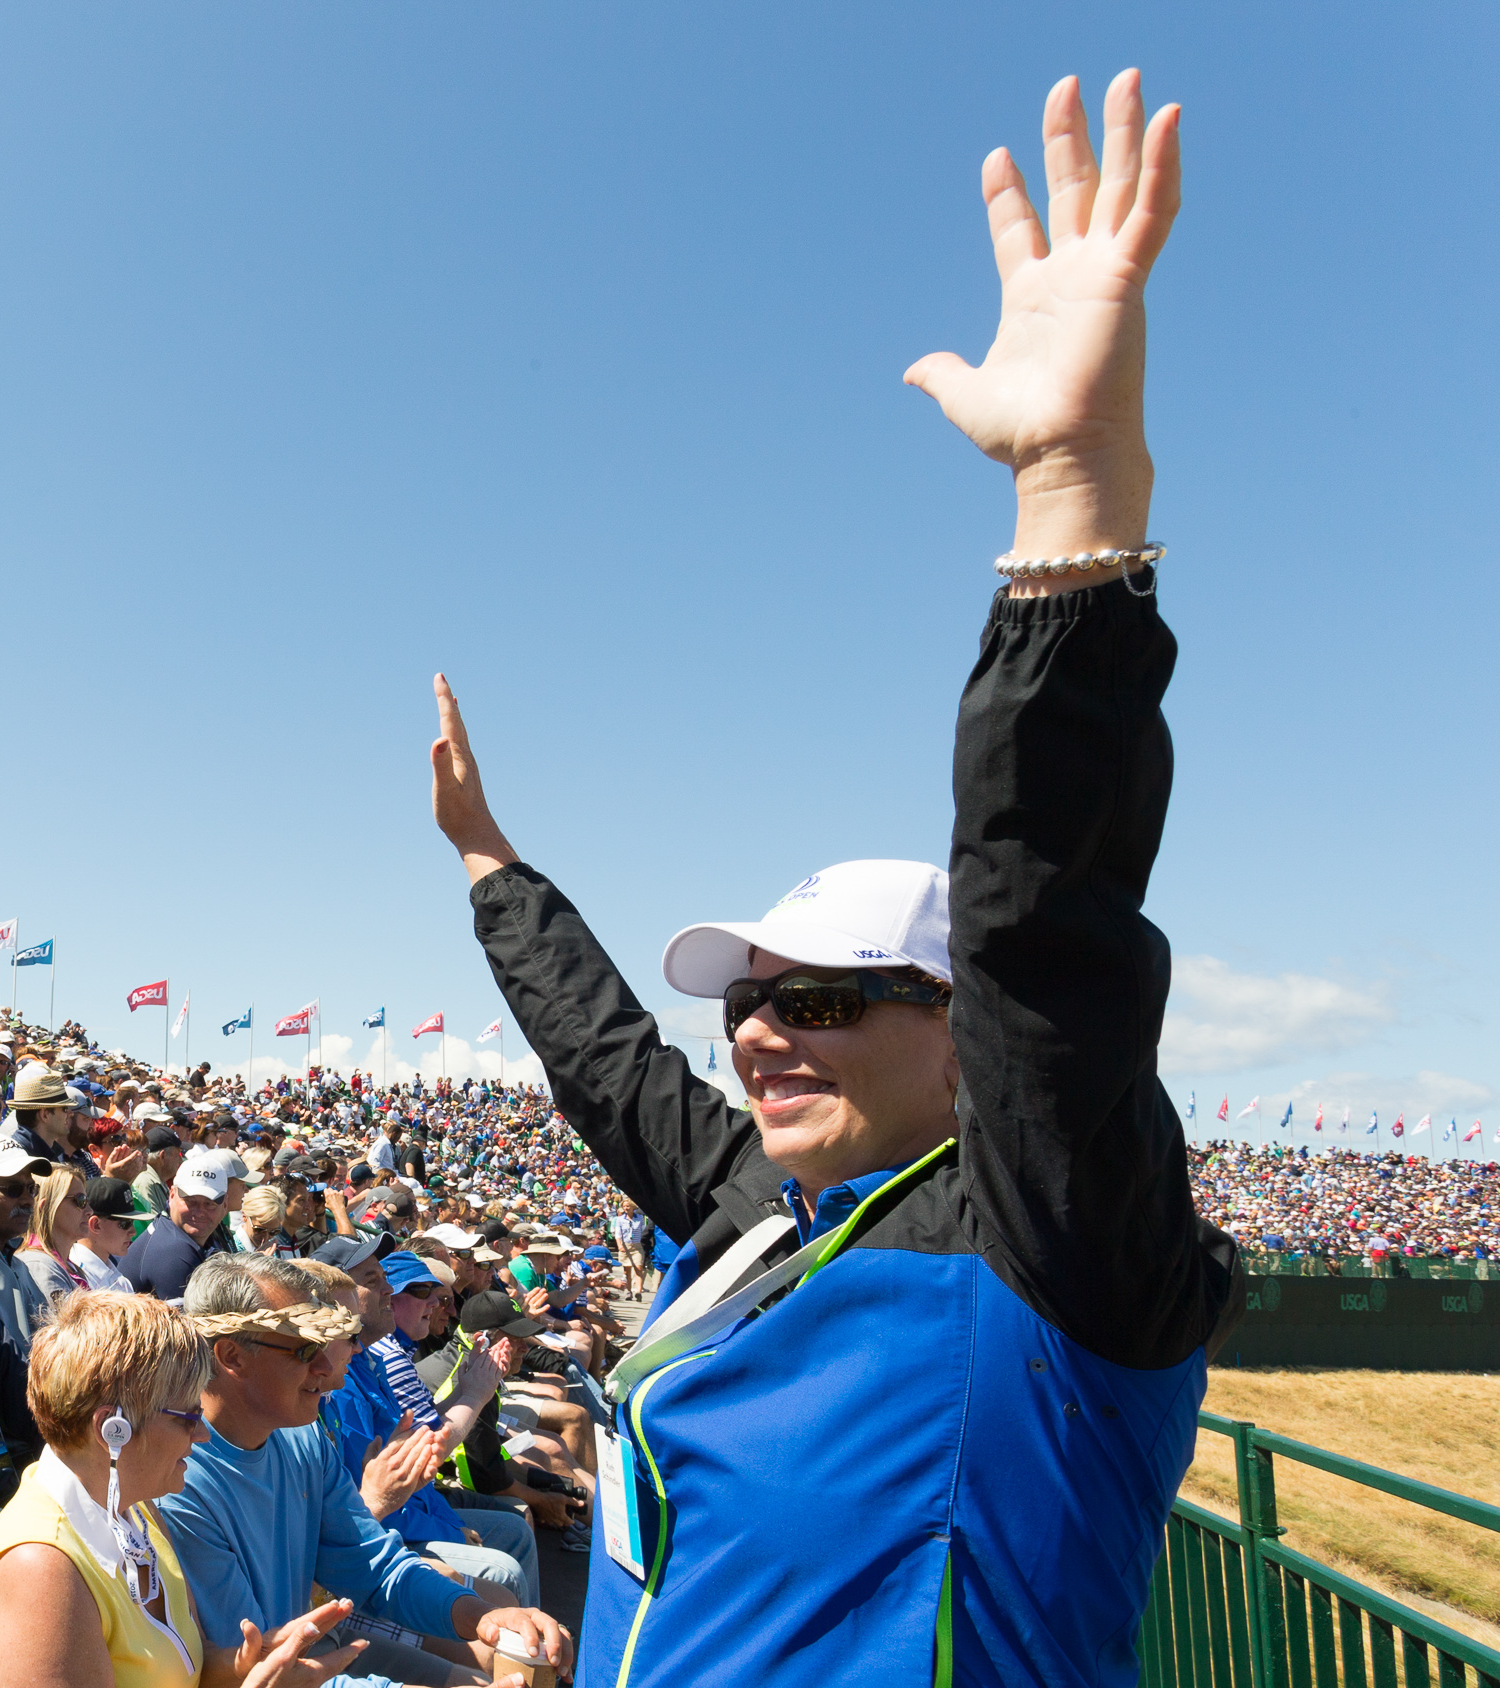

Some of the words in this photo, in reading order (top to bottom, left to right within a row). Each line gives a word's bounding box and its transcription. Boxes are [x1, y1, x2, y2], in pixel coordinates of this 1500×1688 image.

[853, 950, 888, 959] USGA
[191, 1170, 217, 1180] IZOD
[1245, 1292, 1262, 1310] GA
[1340, 1294, 1370, 1311] USGA
[1441, 1296, 1469, 1312] USGA
[149, 1546, 157, 1590] AMERICAN
